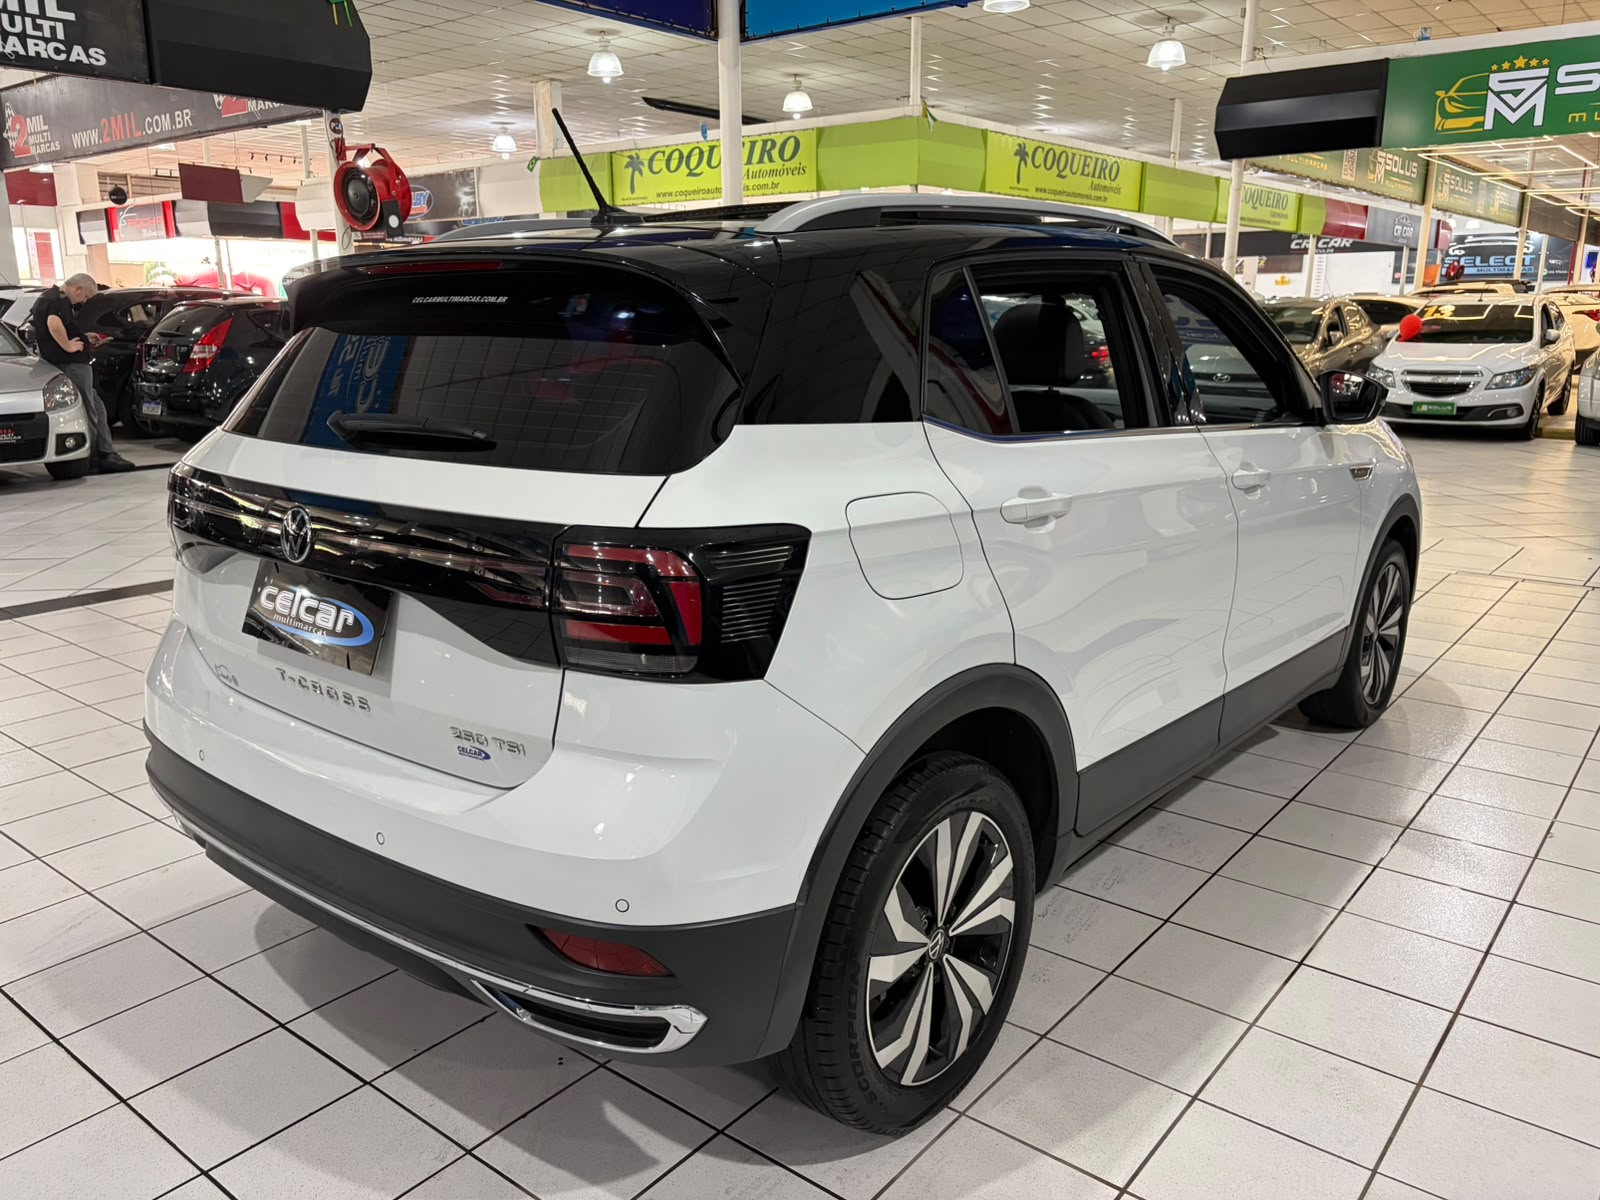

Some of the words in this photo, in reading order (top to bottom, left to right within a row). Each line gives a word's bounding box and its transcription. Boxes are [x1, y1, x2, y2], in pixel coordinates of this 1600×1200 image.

[0, 13, 65, 40] ULTI
[0, 34, 107, 66] ARCAS
[26, 114, 49, 134] MIL
[71, 108, 193, 149] WWW.2MIL.COM.BR
[28, 131, 51, 146] MULTI
[30, 140, 61, 155] MARCAS
[647, 135, 802, 178] COQUIRO
[1031, 145, 1121, 182] COQUEIRO
[1386, 152, 1419, 179] SOLUS
[743, 163, 807, 181] Automóveis
[655, 181, 780, 199] www.coqueiroautois.com.br
[1243, 186, 1289, 211] OQUEIRO
[1317, 237, 1354, 248] CAR
[1444, 255, 1536, 267] SELECT
[259, 585, 355, 633] celcar
[273, 612, 327, 638] multimarcas
[275, 667, 371, 712] T-CROSS
[491, 736, 526, 757] TSI
